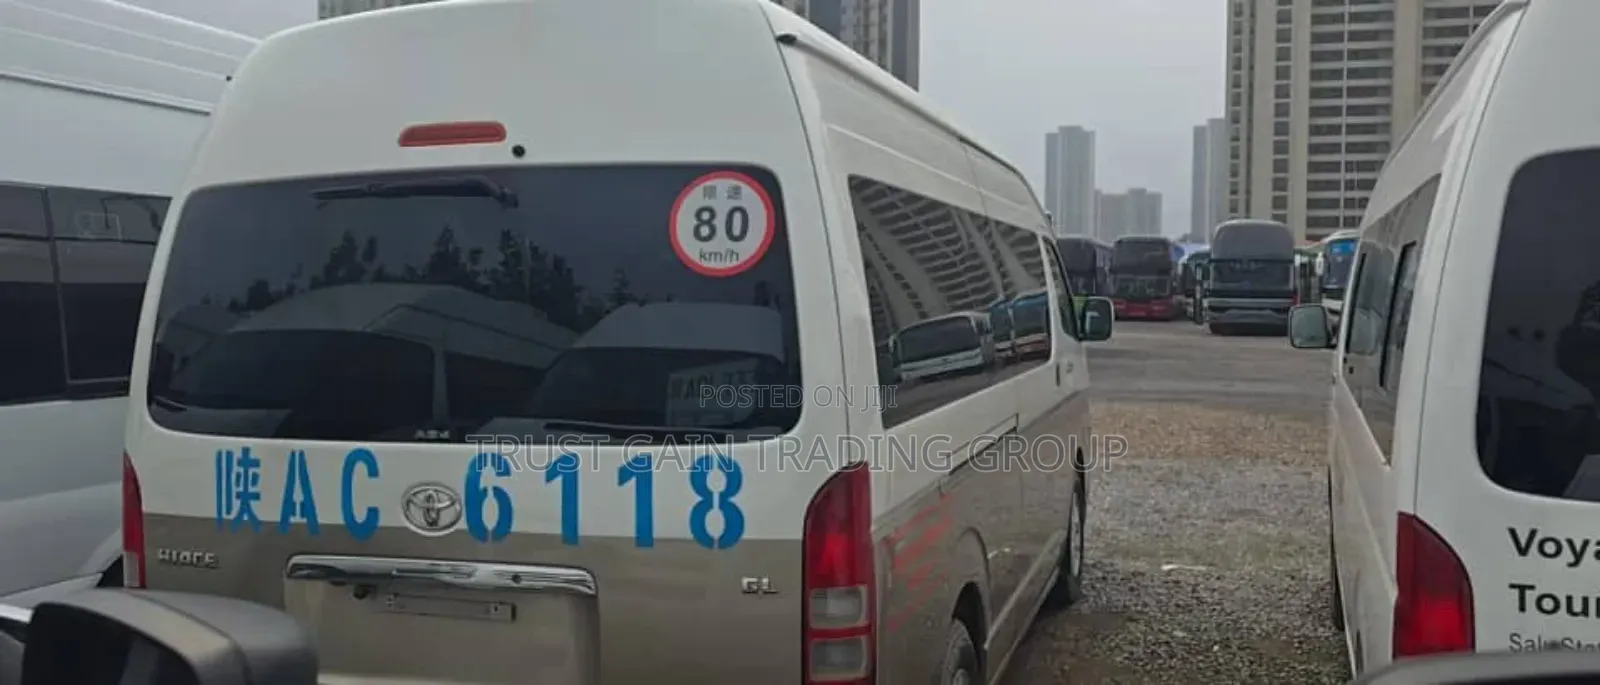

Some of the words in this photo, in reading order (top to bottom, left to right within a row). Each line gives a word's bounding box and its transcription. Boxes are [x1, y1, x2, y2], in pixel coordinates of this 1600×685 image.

[693, 205, 749, 243] 80
[699, 247, 740, 264] km/h
[463, 451, 746, 550] 6118
